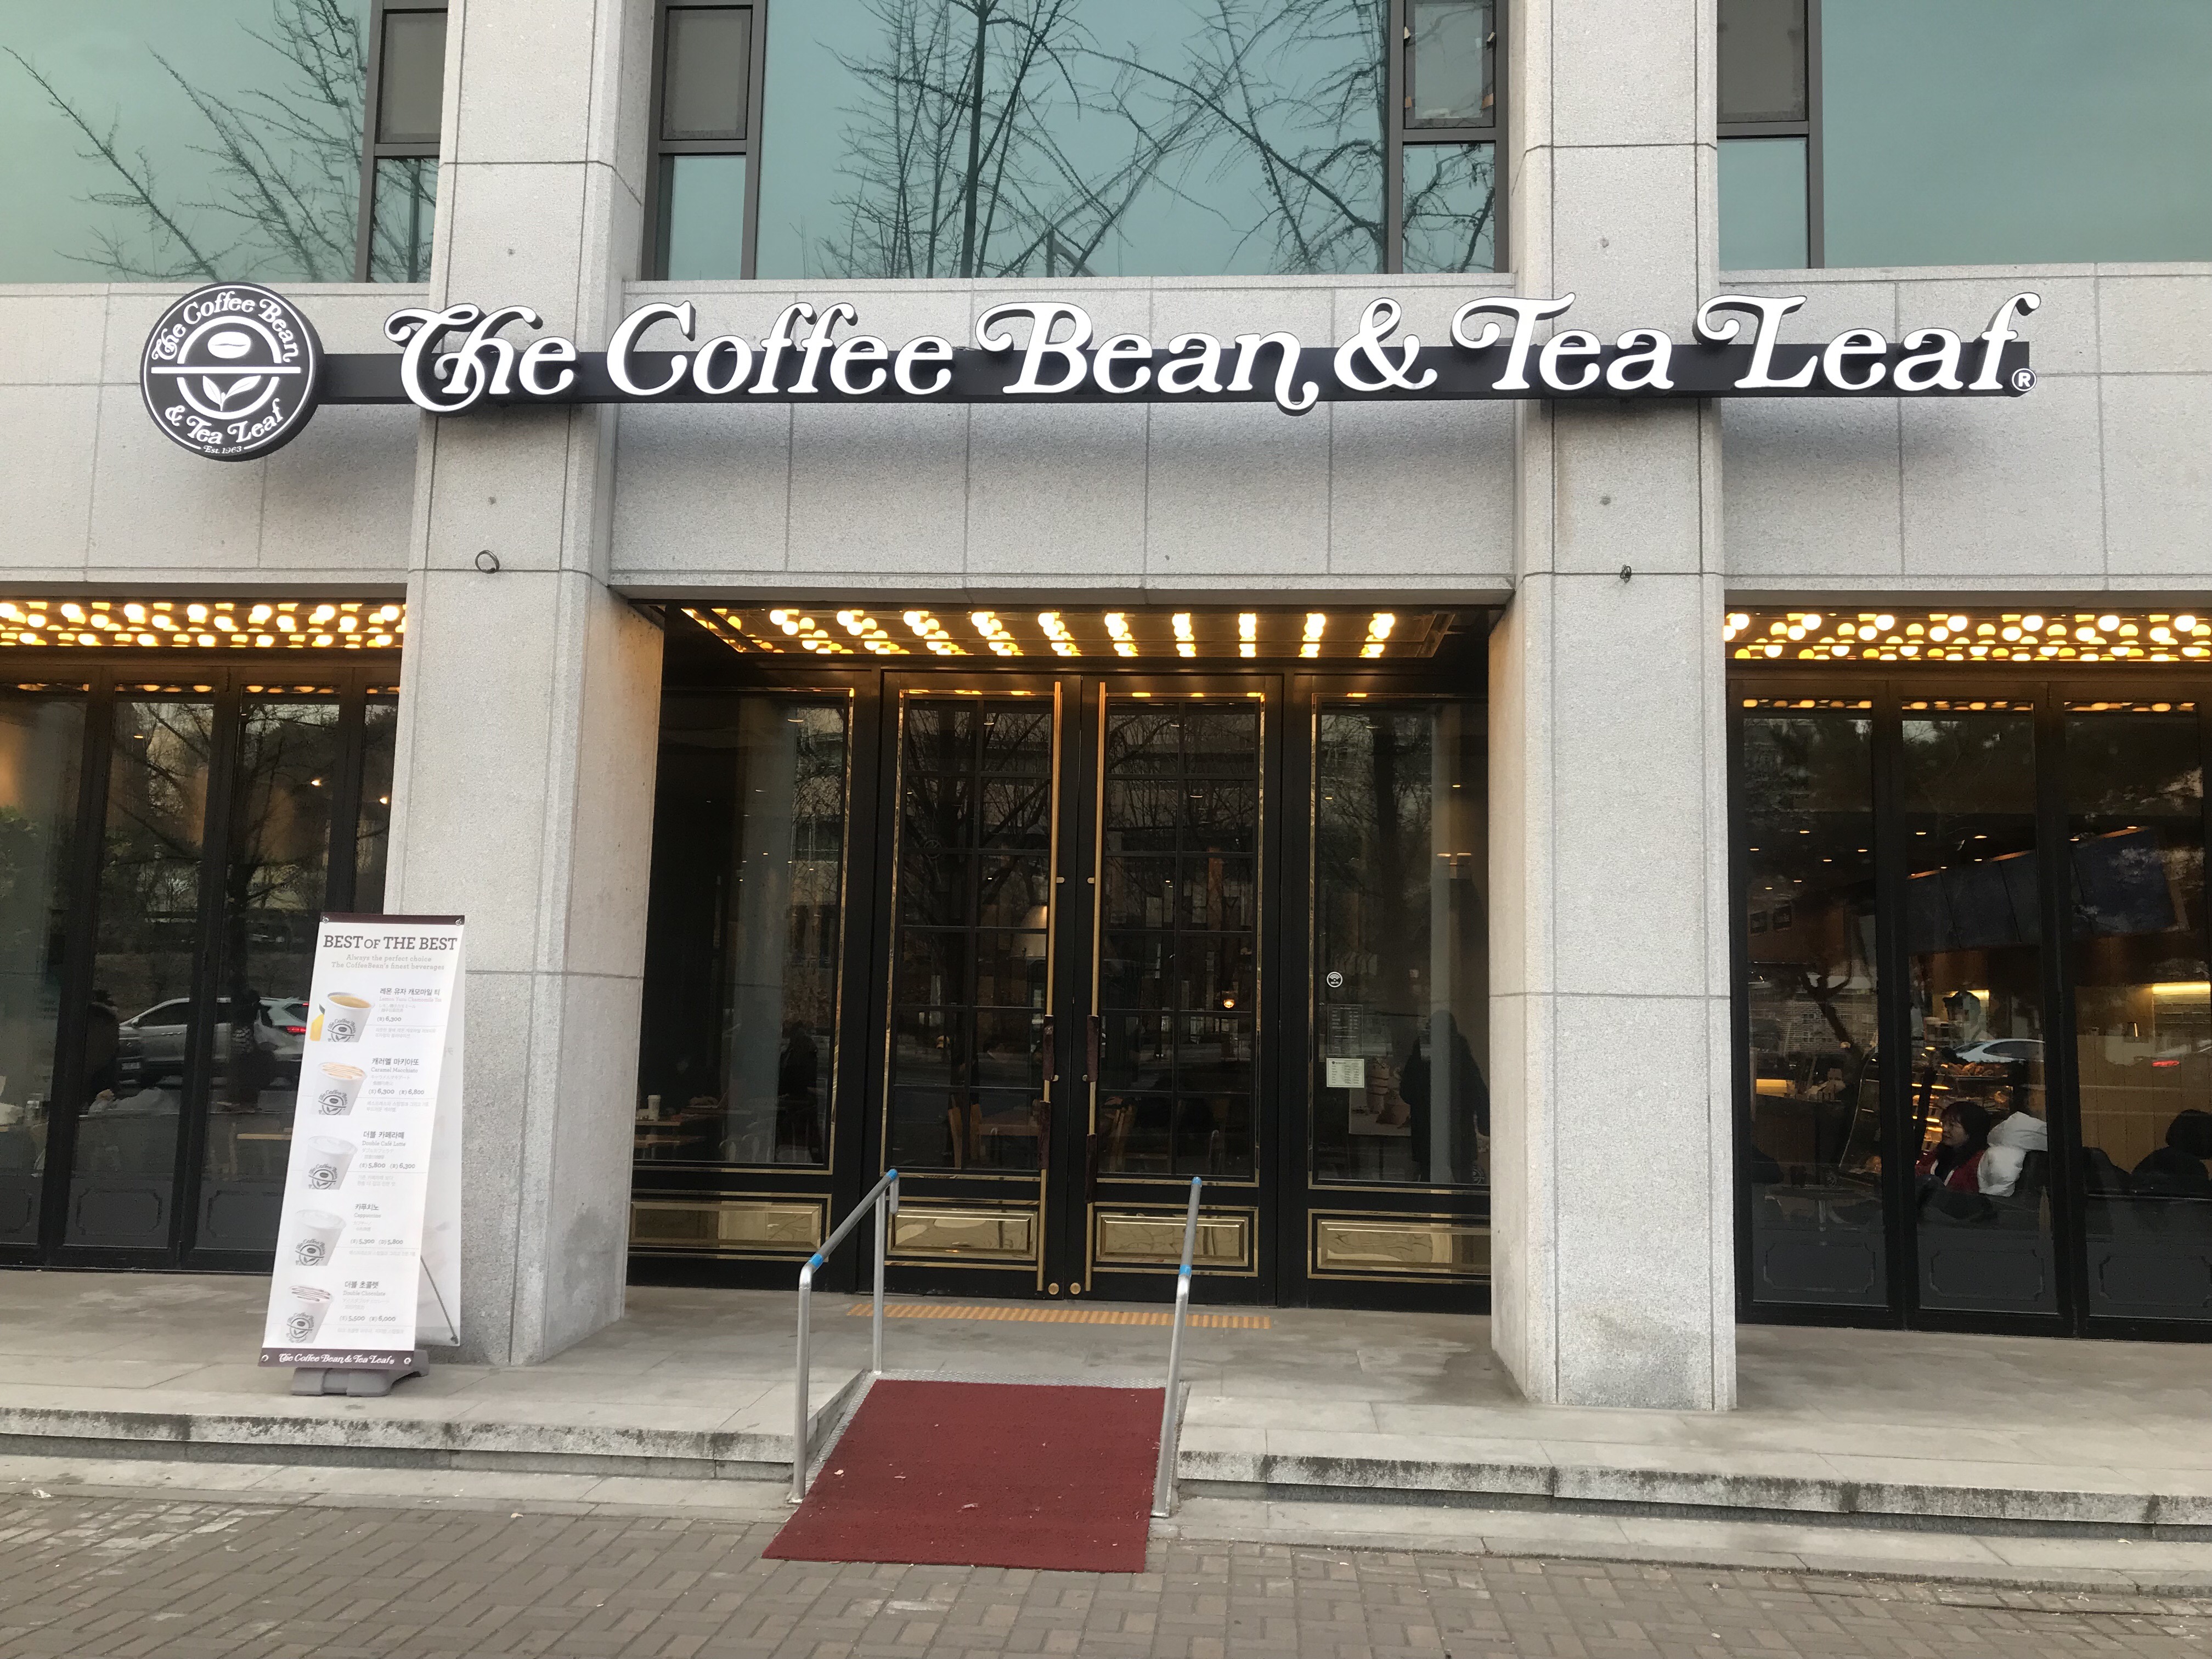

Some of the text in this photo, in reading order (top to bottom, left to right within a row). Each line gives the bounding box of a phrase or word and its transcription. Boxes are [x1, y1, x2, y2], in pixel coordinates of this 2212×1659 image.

[151, 291, 300, 363] The Coffee Bean
[383, 301, 577, 413] The
[606, 300, 954, 396] Coffee
[975, 301, 1319, 413] Bean
[1333, 297, 1438, 392] &
[1451, 292, 1675, 391] Tea
[165, 398, 284, 444] & Tea Leaf
[221, 445, 242, 454] 1963
[323, 935, 458, 950] BEST OF THE BEST
[393, 1058, 419, 1066] 마키아또
[294, 1353, 320, 1362] Coffee
[320, 1354, 344, 1364] Bean
[344, 1355, 352, 1363] &
[353, 1355, 368, 1363] Tea
